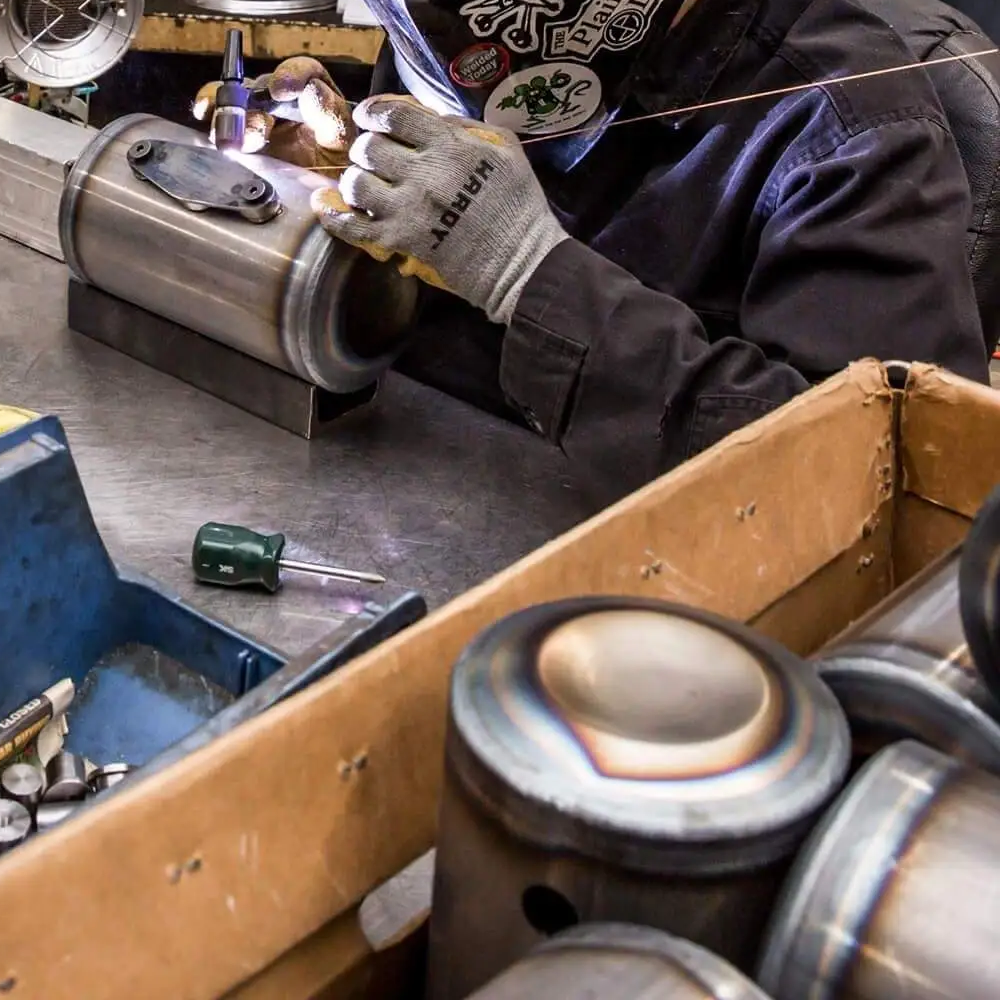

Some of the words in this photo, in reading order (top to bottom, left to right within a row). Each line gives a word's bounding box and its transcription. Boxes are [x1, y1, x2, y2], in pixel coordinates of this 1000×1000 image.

[554, 30, 565, 49] THE
[460, 47, 497, 76] Welded
[467, 58, 499, 82] Today
[430, 159, 495, 251] HARDY
